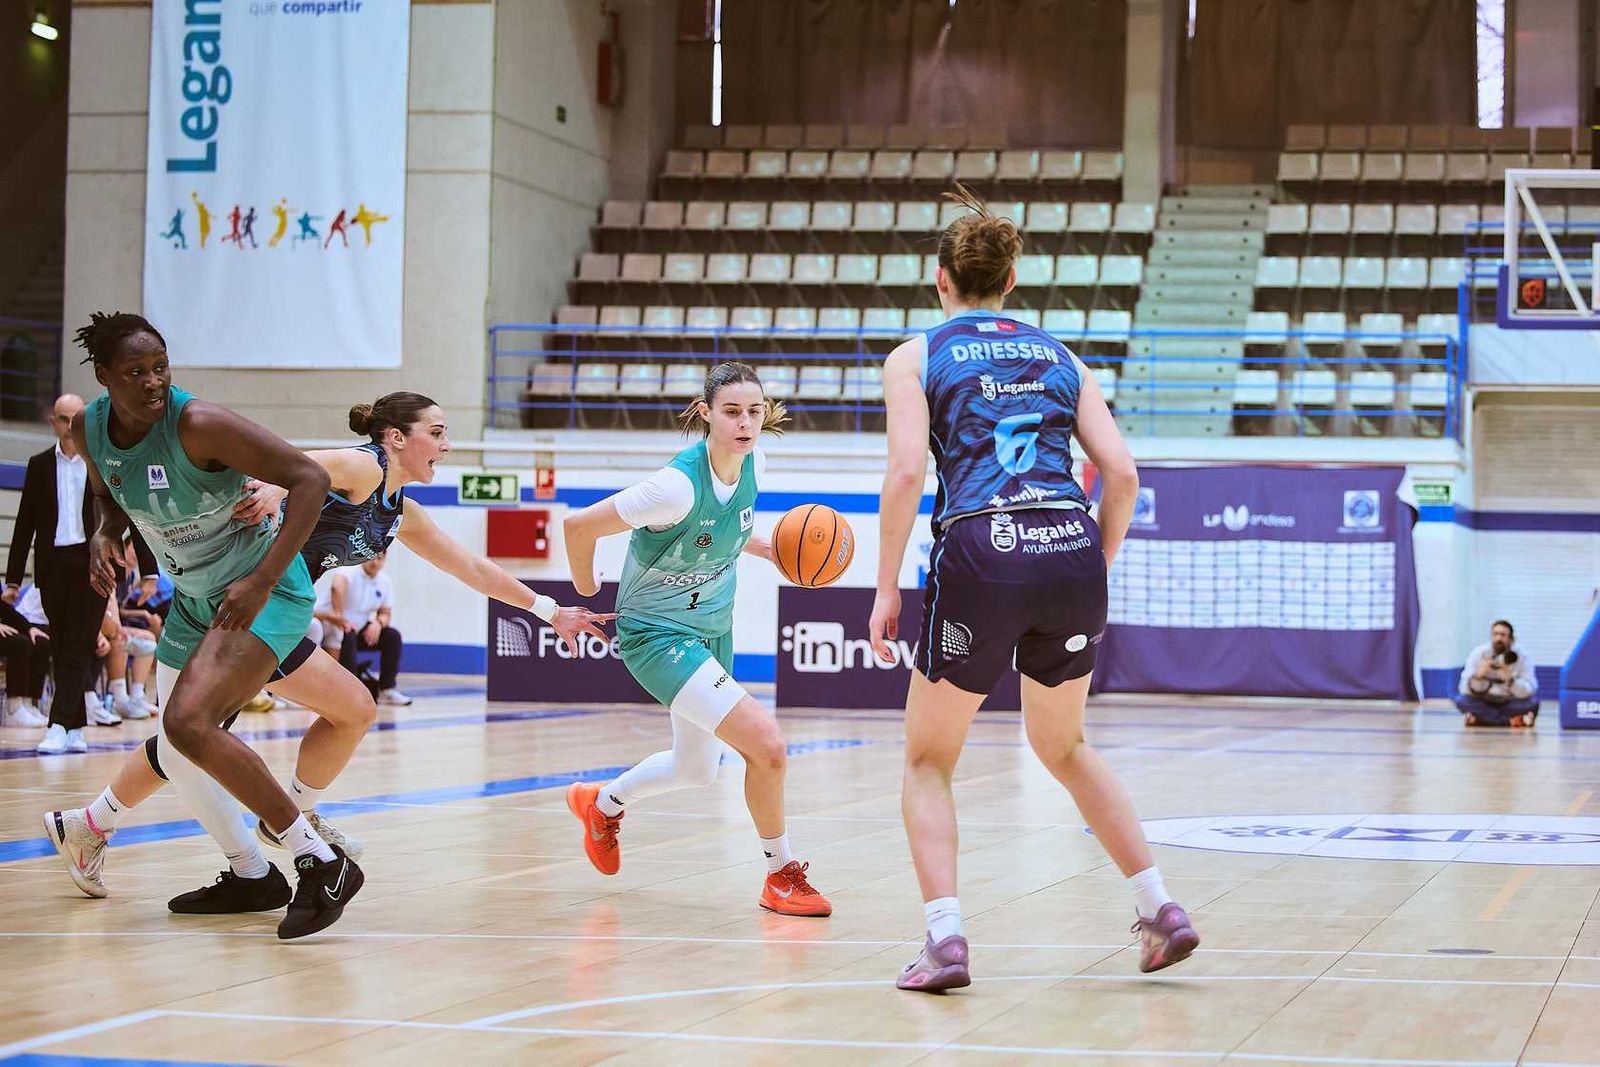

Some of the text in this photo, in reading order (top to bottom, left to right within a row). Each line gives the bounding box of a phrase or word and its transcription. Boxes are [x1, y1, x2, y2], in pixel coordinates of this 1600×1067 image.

[282, 0, 362, 16] compartir
[166, 0, 233, 173] Legan
[951, 342, 1059, 363] DRIESSEN
[997, 380, 1045, 394] Leganés
[994, 412, 1043, 476] 6
[105, 459, 122, 467] vive
[1017, 520, 1085, 543] Leganés
[1022, 537, 1091, 554] AYUNTAMIENTO
[686, 591, 700, 611] 1
